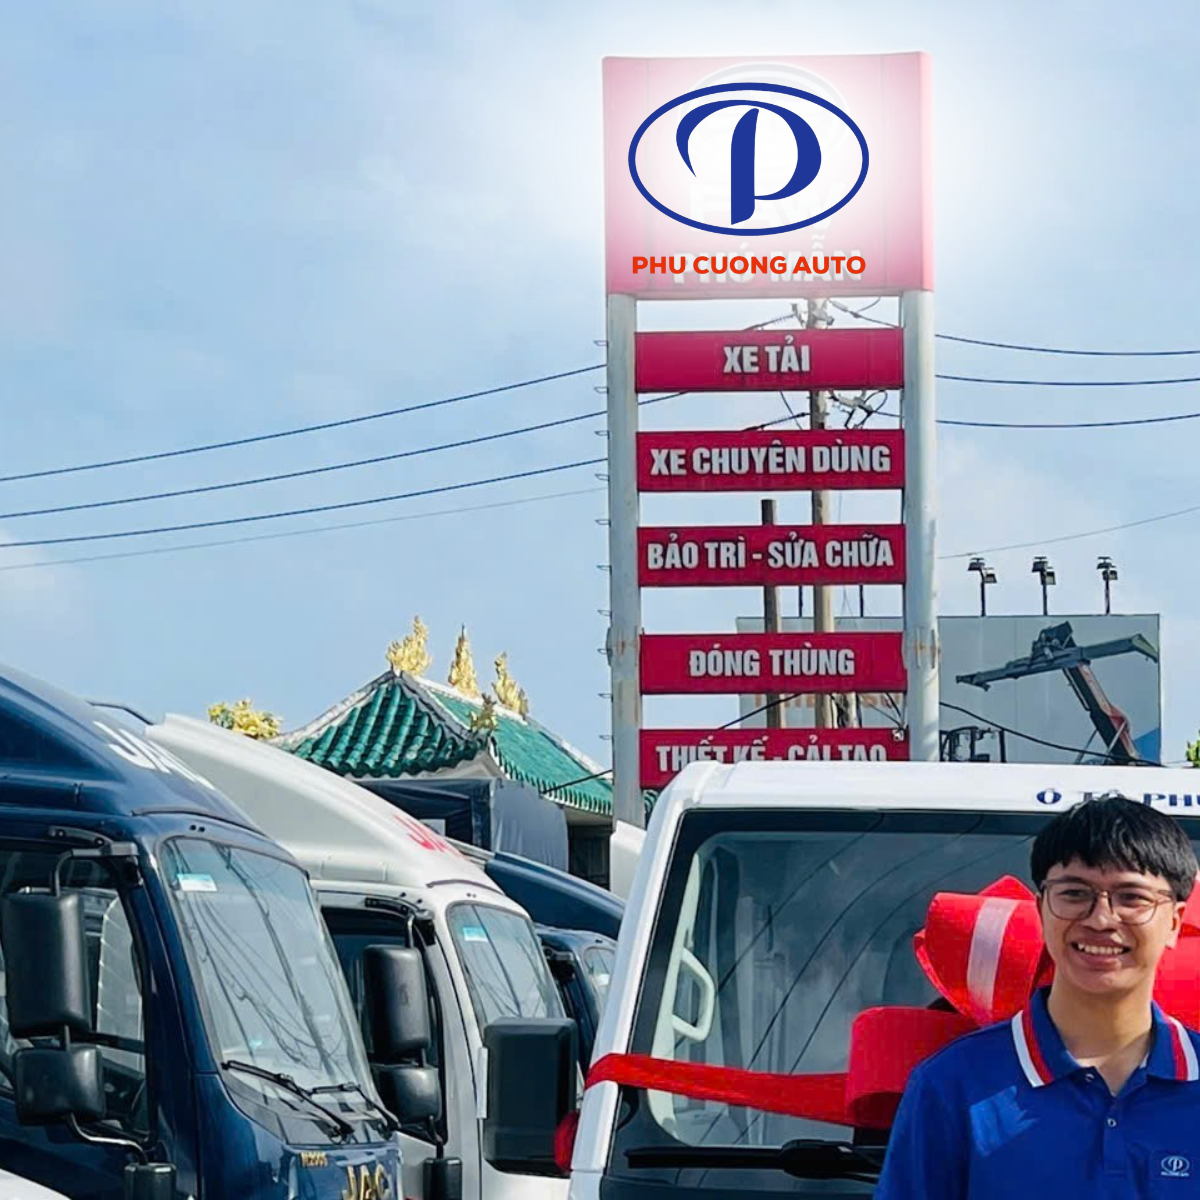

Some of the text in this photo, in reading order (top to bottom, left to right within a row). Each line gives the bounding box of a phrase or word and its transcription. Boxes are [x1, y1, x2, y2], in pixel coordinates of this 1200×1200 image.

[722, 335, 811, 374] XE TẢI
[650, 438, 891, 476] XE CHUYÊN DÙNG
[647, 533, 699, 570] BẢO
[704, 536, 746, 569] TRÌ
[767, 531, 819, 569] SỬA
[825, 533, 894, 567] CHỮA
[689, 641, 856, 677] ĐÓNG THÙNG
